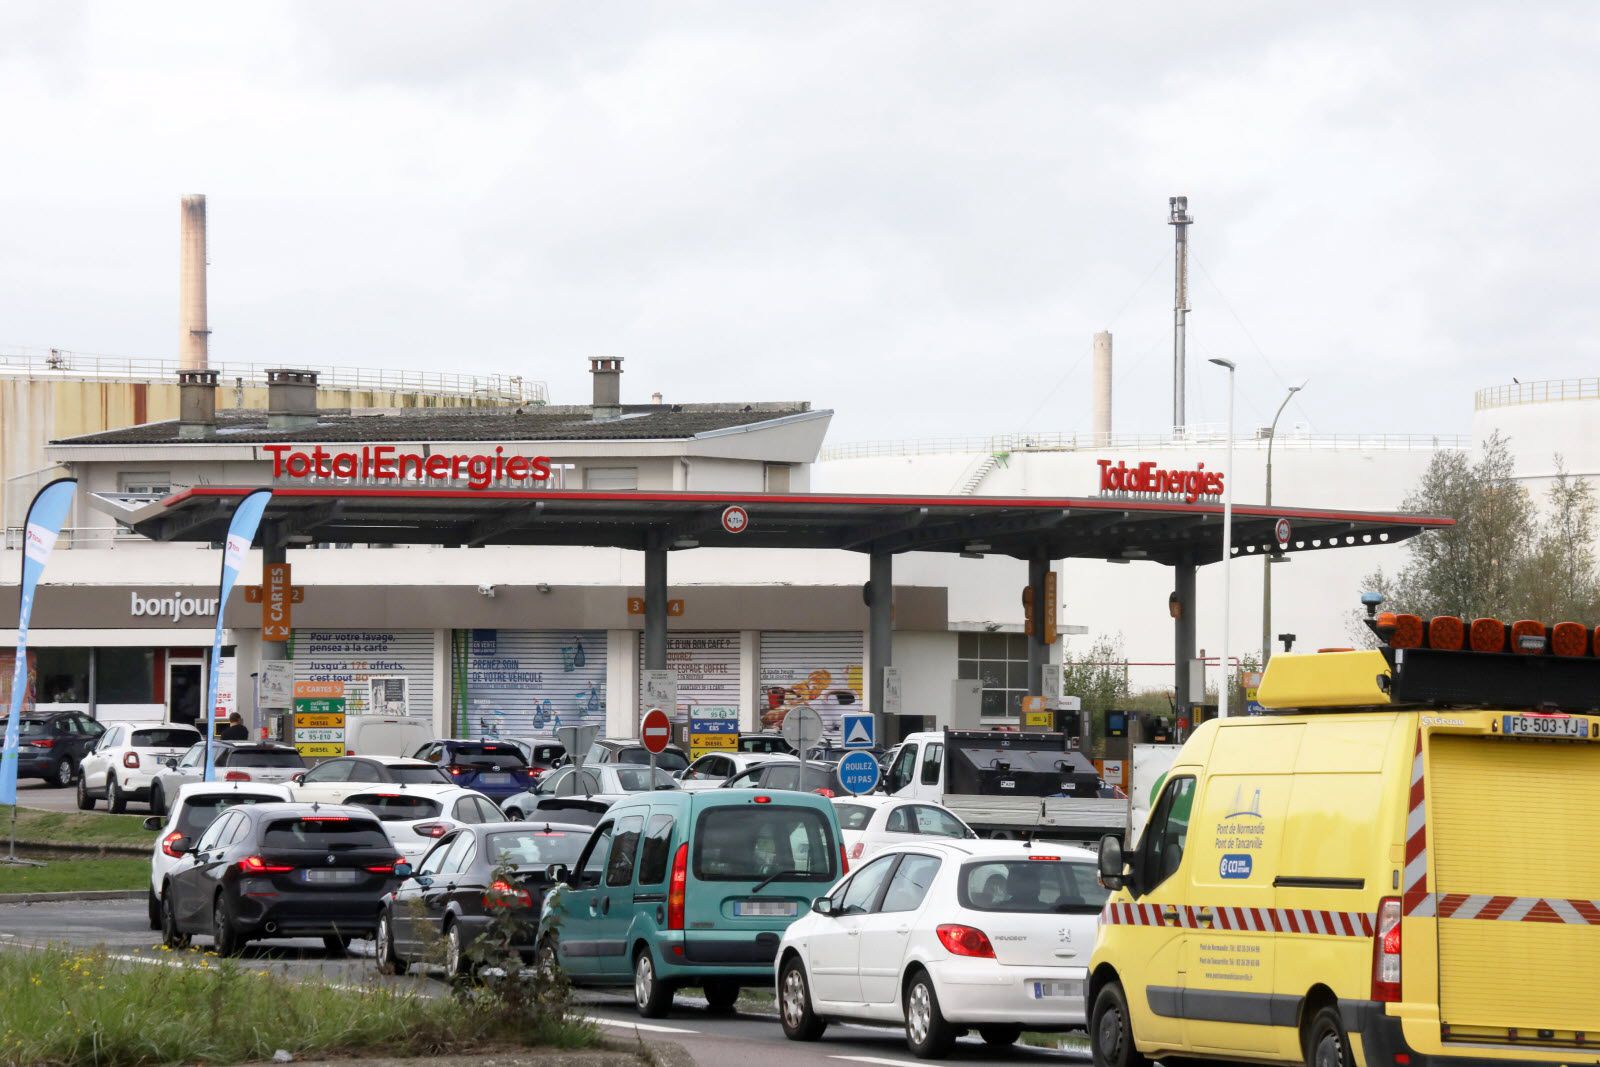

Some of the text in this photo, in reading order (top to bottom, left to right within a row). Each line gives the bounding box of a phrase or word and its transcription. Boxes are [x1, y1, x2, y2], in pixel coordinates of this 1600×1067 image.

[263, 445, 551, 490] TotalEnergies
[1097, 459, 1224, 504] TotalEnergies
[271, 568, 283, 622] CARTES
[292, 590, 299, 600] 2
[131, 591, 219, 623] bonjour
[632, 601, 640, 611] 3
[672, 602, 680, 613] 4
[310, 632, 396, 643] Pour votre lavage,
[309, 644, 342, 654] pensez
[352, 643, 361, 652] la
[364, 644, 388, 652] carte
[692, 639, 707, 649] BON
[309, 661, 347, 671] Jusqu'à
[369, 661, 406, 671] offerts,
[473, 659, 519, 670] PRENEZ SOIN
[677, 664, 702, 673] ESPACE
[704, 663, 728, 673] COFFEE
[309, 673, 331, 682] c'est
[333, 673, 353, 682] tout
[473, 671, 481, 682] DE
[484, 671, 509, 682] VOTRE
[1512, 717, 1579, 734] FG-503-YJ
[845, 762, 872, 770] ROULEZ
[847, 775, 872, 784] AU PAS
[1216, 822, 1265, 835] Pont de Normandie
[1215, 837, 1263, 849] Pont de Tancarville
[1228, 860, 1238, 873] CCI
